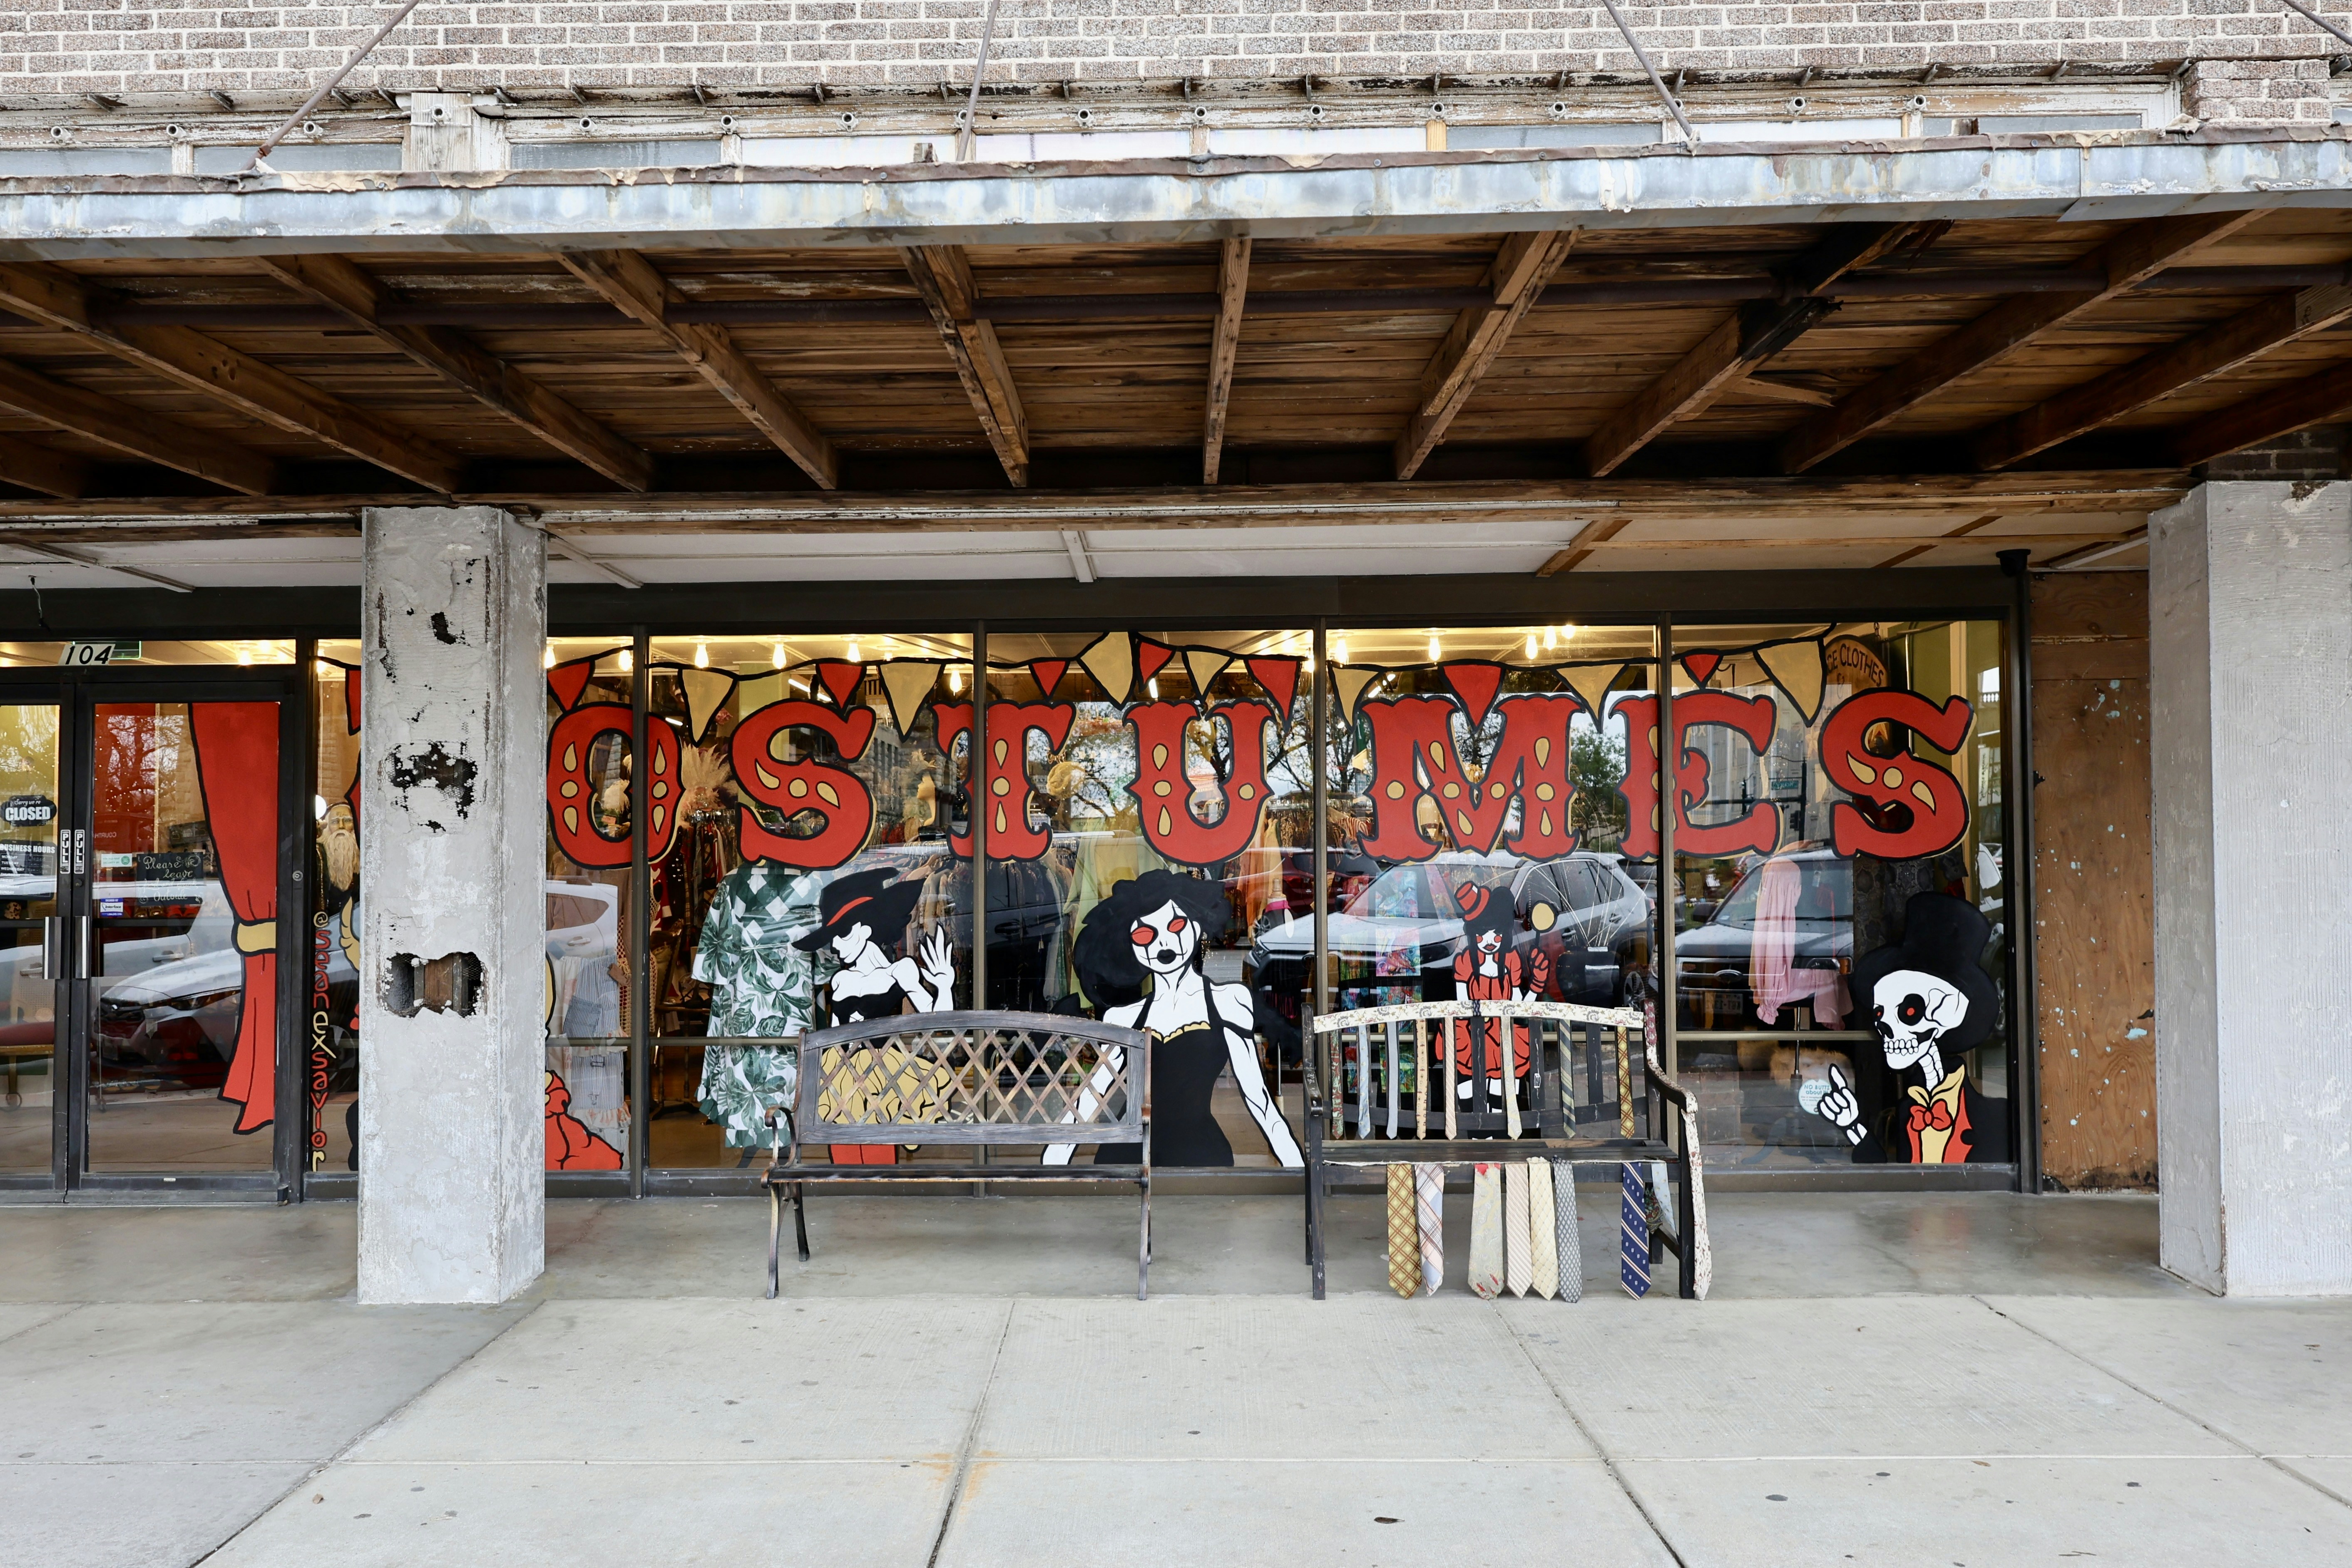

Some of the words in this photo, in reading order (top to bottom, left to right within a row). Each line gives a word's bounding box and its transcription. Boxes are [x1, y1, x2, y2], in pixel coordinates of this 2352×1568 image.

[65, 645, 112, 665] 104
[1840, 644, 1884, 687] CLOTHES
[344, 688, 1977, 870] OSTUMES
[5, 806, 50, 820] CLOSED
[0, 843, 32, 852] BUSINESS
[143, 855, 182, 870] Please
[163, 869, 193, 878] leave
